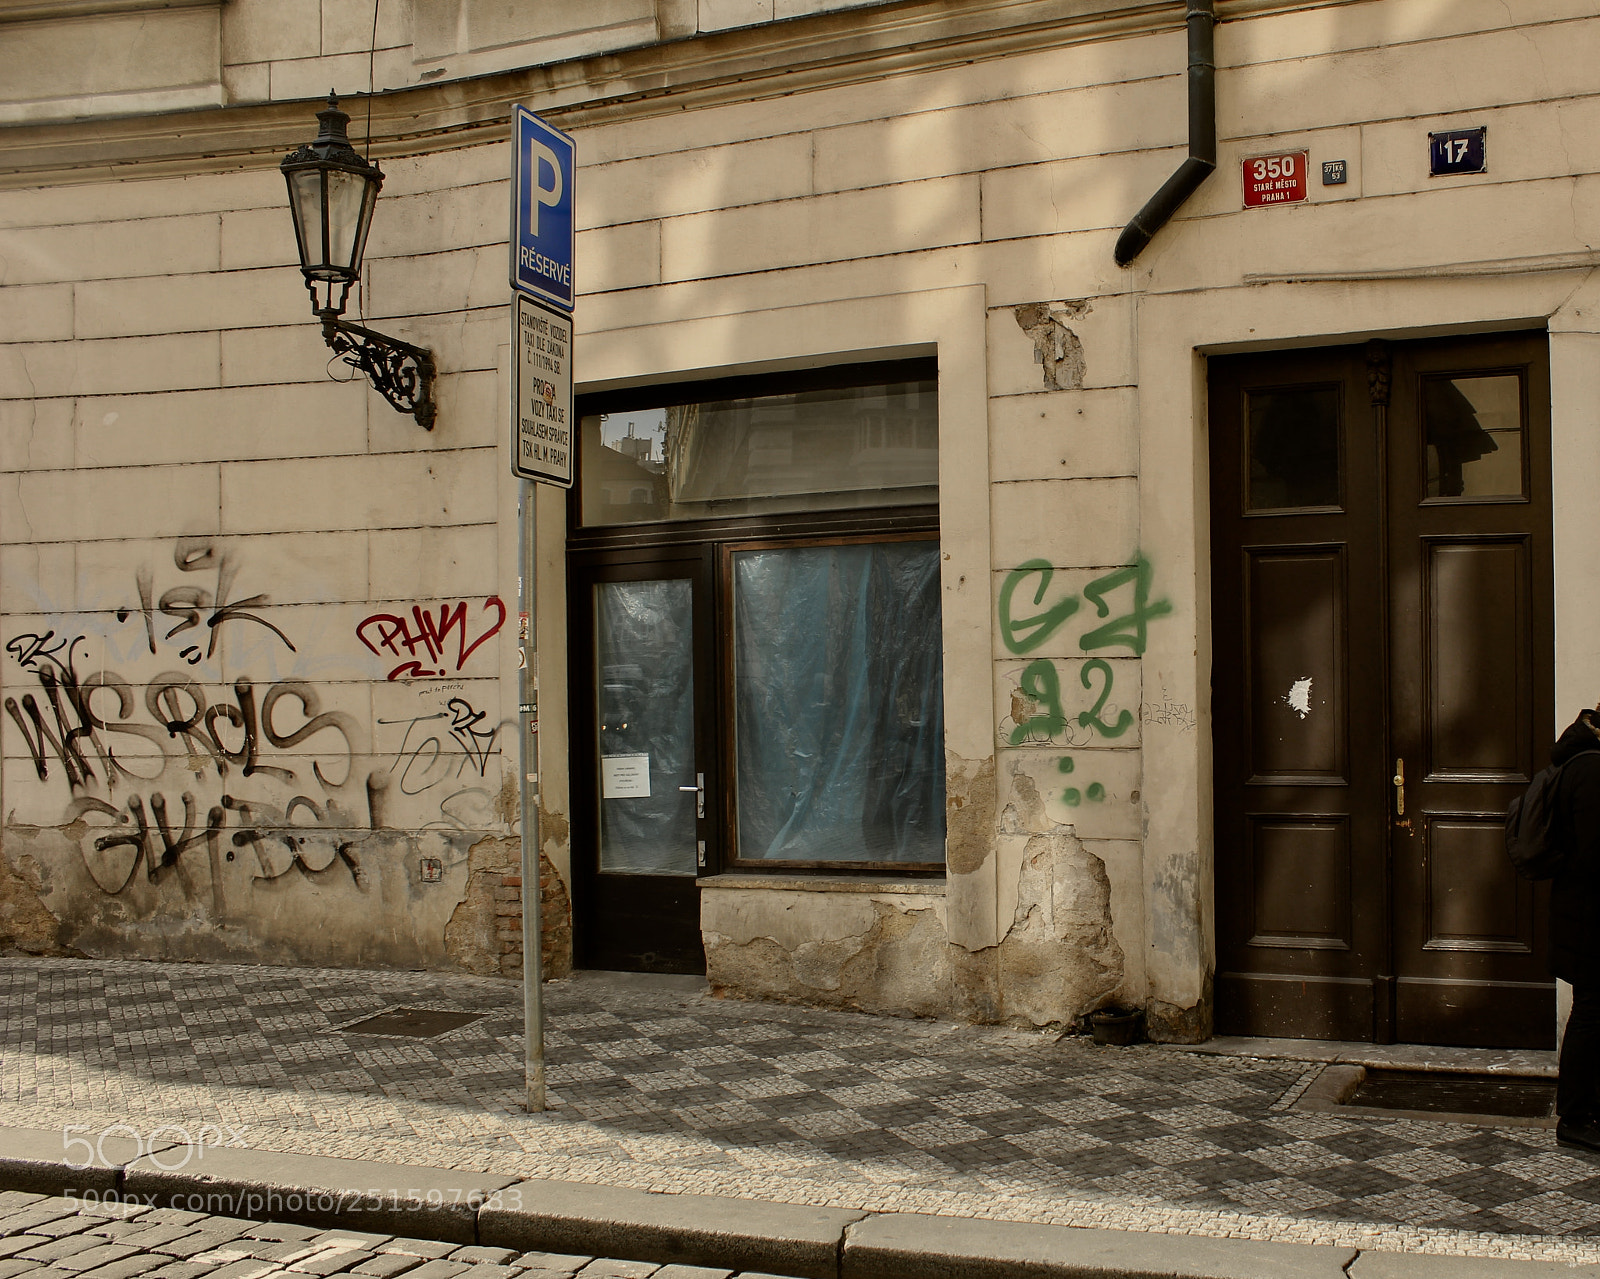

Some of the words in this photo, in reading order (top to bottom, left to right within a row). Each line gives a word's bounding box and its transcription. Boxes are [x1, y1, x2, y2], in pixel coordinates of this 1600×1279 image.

[1444, 138, 1469, 164] 17
[1253, 156, 1295, 180] 350
[530, 137, 563, 237] P
[1253, 180, 1274, 192] STARÉ
[1275, 178, 1297, 190] MĚSTO
[1261, 191, 1285, 203] PRAHA
[1286, 191, 1290, 200] 1
[521, 245, 571, 287] RÉSERVÉ
[524, 330, 535, 348] TAXI
[537, 335, 546, 352] DLE
[550, 323, 568, 344] VOZIDEL
[531, 398, 545, 419] VOZY
[558, 408, 565, 424] SE
[521, 417, 548, 441] SOUHLASEM
[522, 439, 533, 459] TSK
[550, 447, 568, 469] PRAHY
